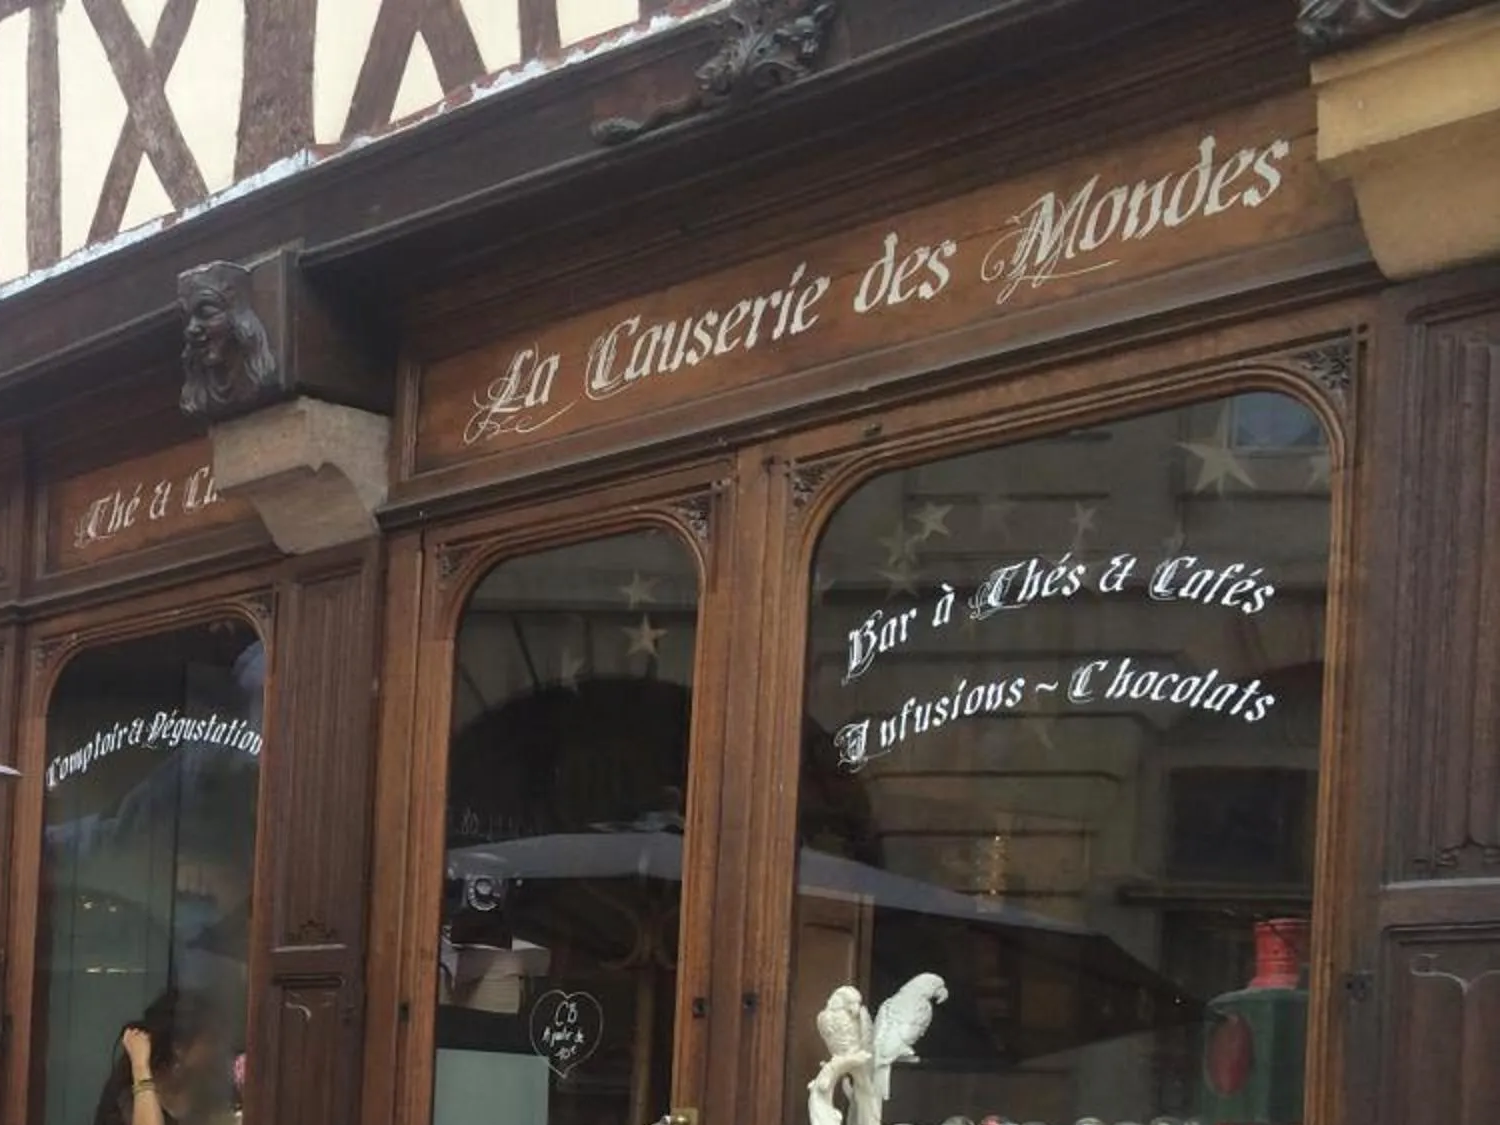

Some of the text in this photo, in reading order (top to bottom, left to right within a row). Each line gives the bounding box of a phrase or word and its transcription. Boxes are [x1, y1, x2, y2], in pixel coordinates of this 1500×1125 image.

[463, 134, 1289, 444] La Causerie des Mondes
[74, 482, 142, 548] Thé
[149, 480, 172, 520] &
[841, 552, 1275, 686] Bar à Thés & Cafés
[46, 721, 129, 791] Comptoir
[142, 709, 263, 756] Dégustation
[833, 673, 1025, 773] Infusions
[1068, 657, 1276, 722] Chocolats
